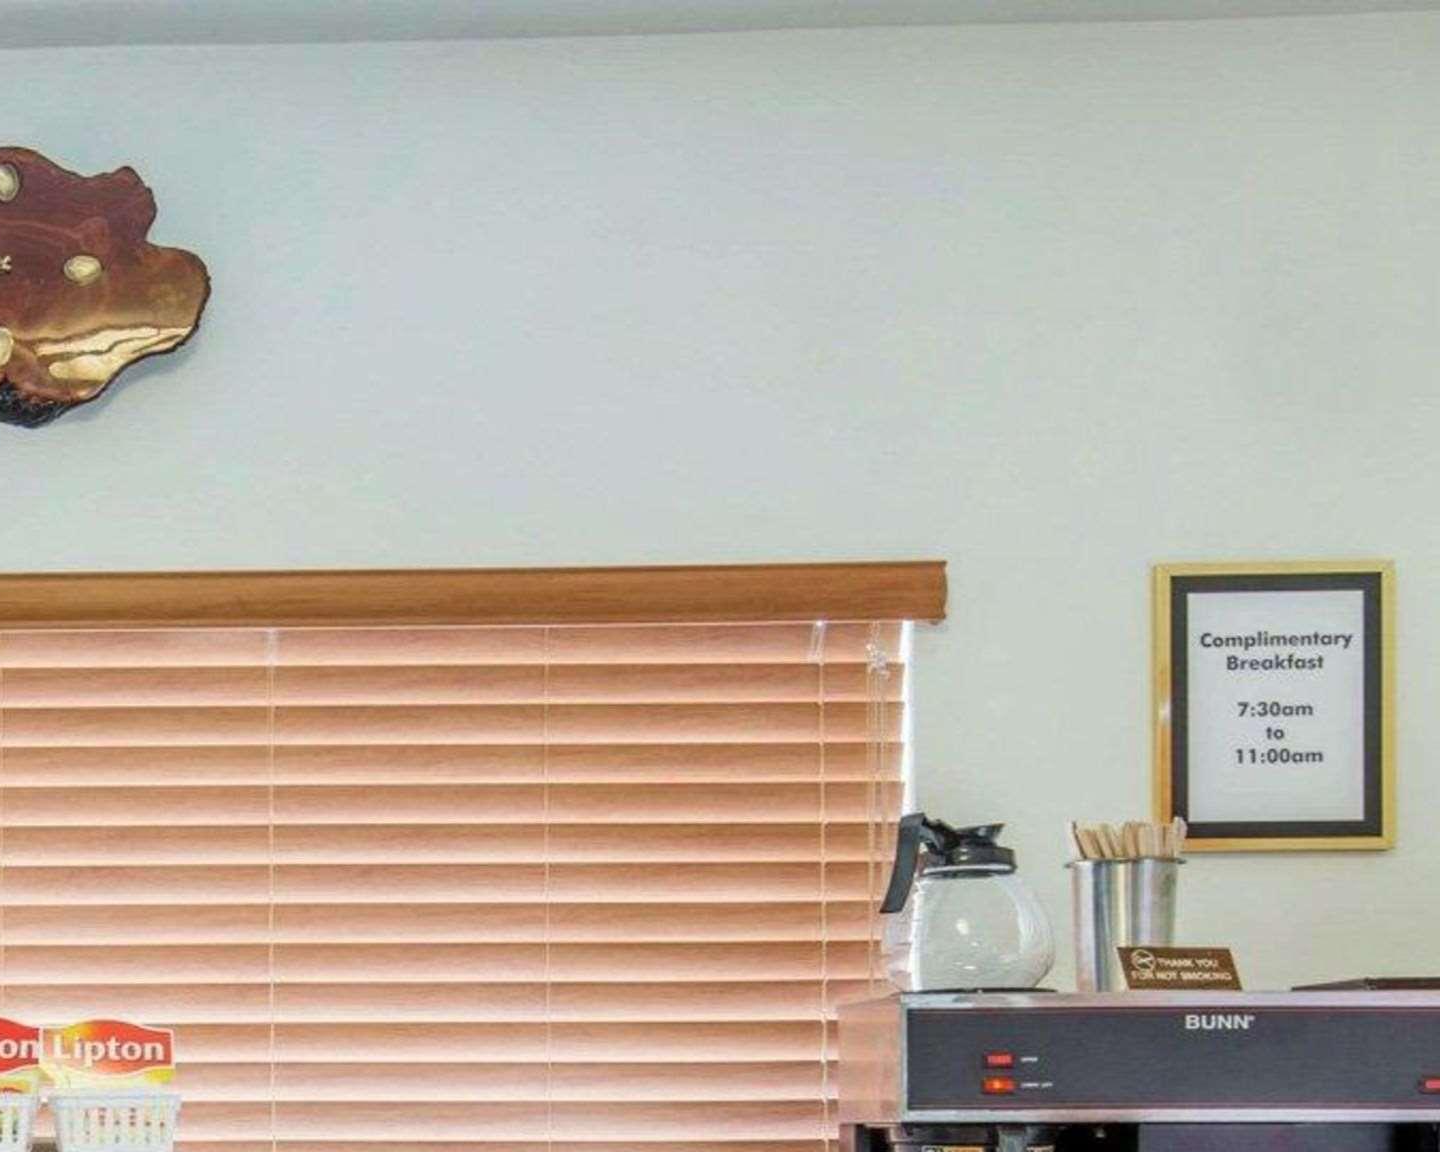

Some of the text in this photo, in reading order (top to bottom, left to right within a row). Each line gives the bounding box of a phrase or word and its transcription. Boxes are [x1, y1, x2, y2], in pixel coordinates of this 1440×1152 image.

[1199, 630, 1353, 651] Complimentary
[1226, 654, 1325, 671] Breakfast
[1237, 701, 1314, 718] 7:30am
[1266, 726, 1285, 741] to
[1236, 747, 1324, 765] 11:00am
[1157, 957, 1219, 968] THANK YOU
[1130, 970, 1233, 981] FOR NOT SMOKING
[53, 1033, 165, 1067] Lipton
